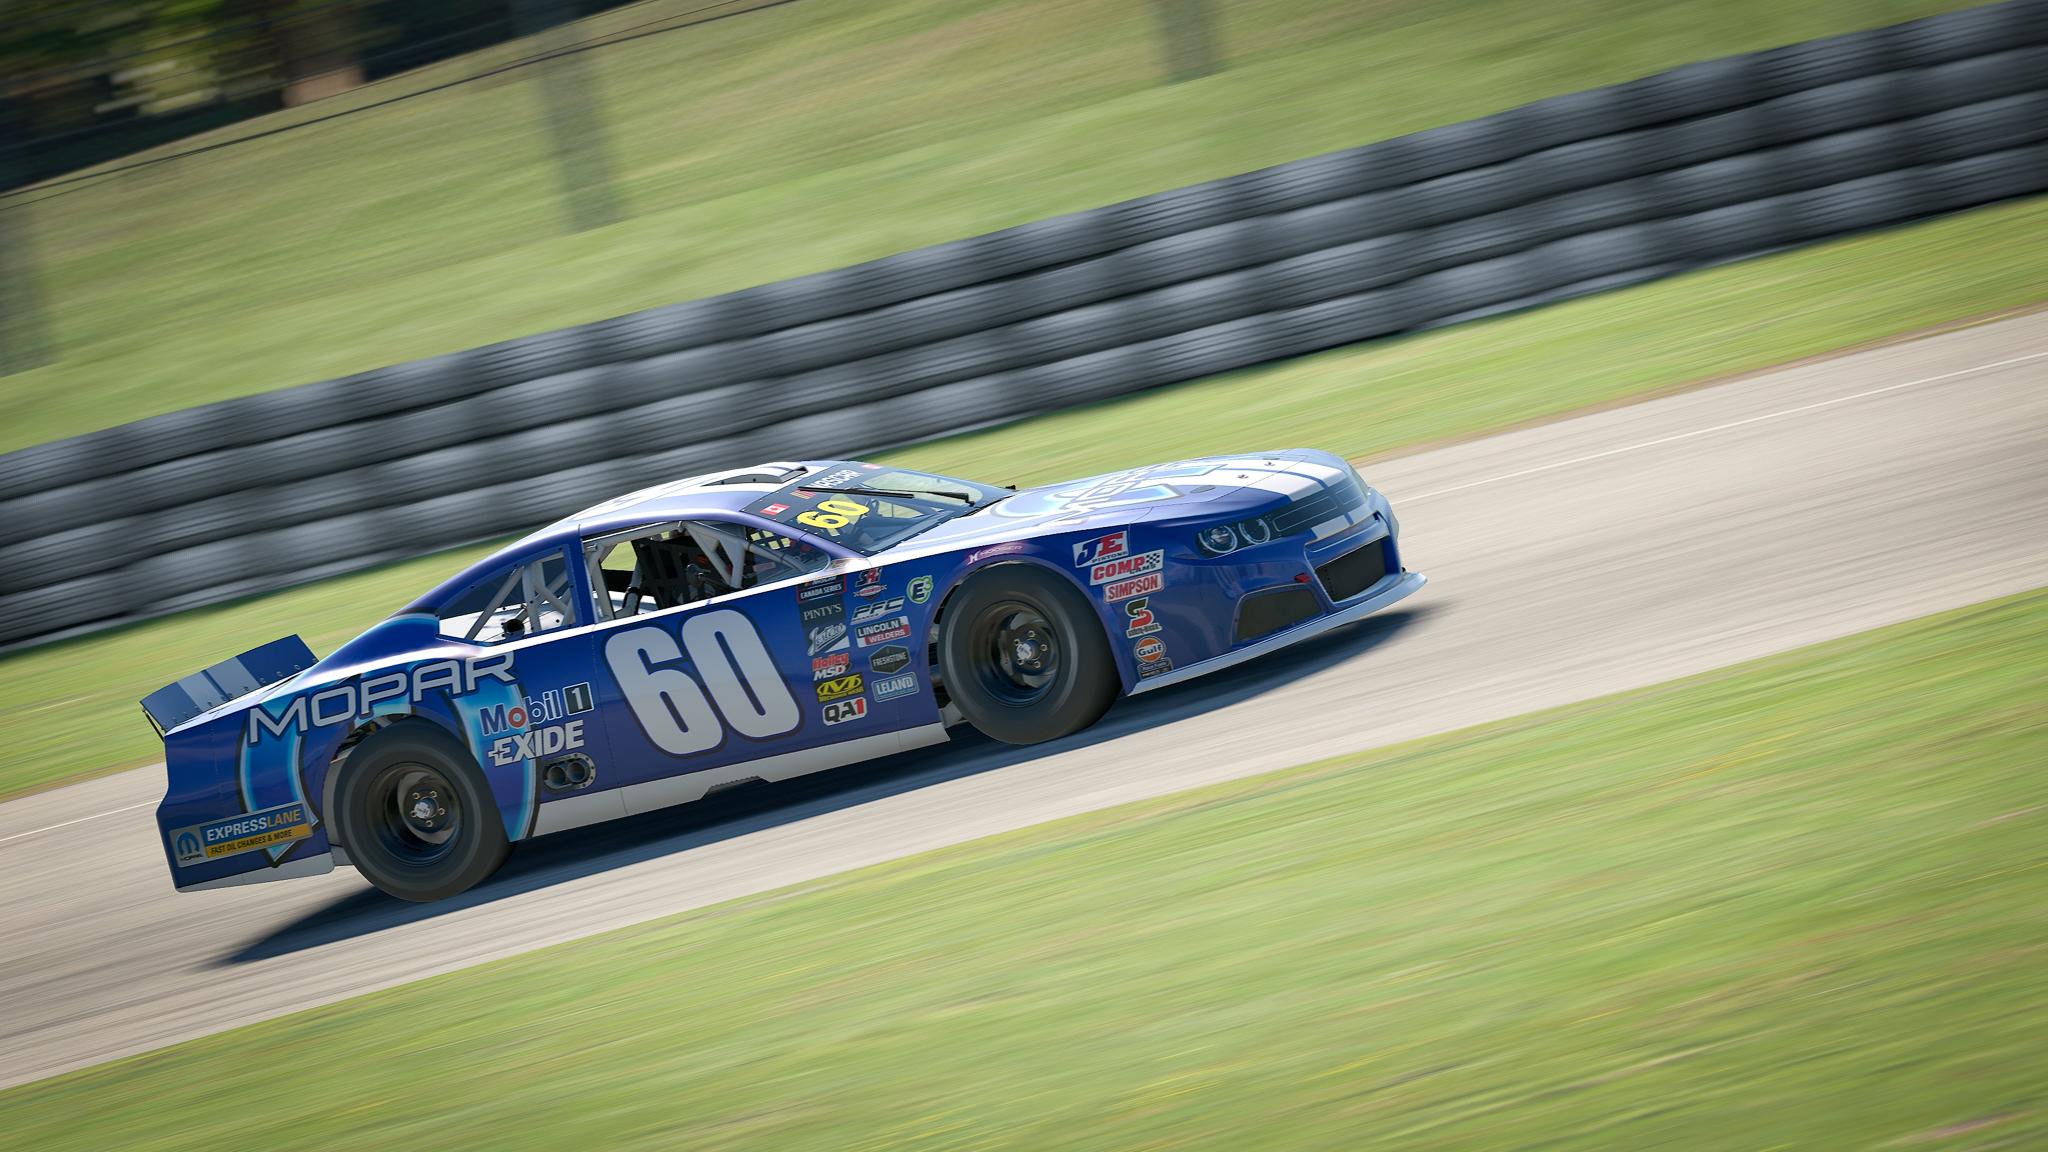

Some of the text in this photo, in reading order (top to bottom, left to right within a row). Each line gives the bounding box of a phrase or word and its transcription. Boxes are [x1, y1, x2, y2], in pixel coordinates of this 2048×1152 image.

[796, 500, 870, 529] 60
[1076, 532, 1124, 567] JE
[1093, 556, 1146, 581] COMP
[800, 587, 824, 599] CANADA
[823, 583, 842, 594] SERIES
[1108, 574, 1159, 600] SIMPSON
[803, 603, 842, 621] PINTY'S
[857, 620, 900, 637] LINCOLN
[868, 629, 906, 644] WELDERS
[812, 653, 849, 672] Holley
[1138, 643, 1162, 657] Gulf
[605, 609, 800, 755] 60
[813, 665, 846, 682] MSD
[876, 676, 914, 696] LELAND
[249, 652, 517, 744] MOPAR
[824, 698, 865, 723] QA1
[480, 690, 563, 737] Mobil
[488, 719, 585, 767] EXIDE
[206, 808, 301, 842] EXPRESSLANE
[211, 845, 225, 855] FAST
[227, 842, 238, 852] OIL
[238, 836, 266, 849] CHANGES
[274, 829, 292, 841] MORE
